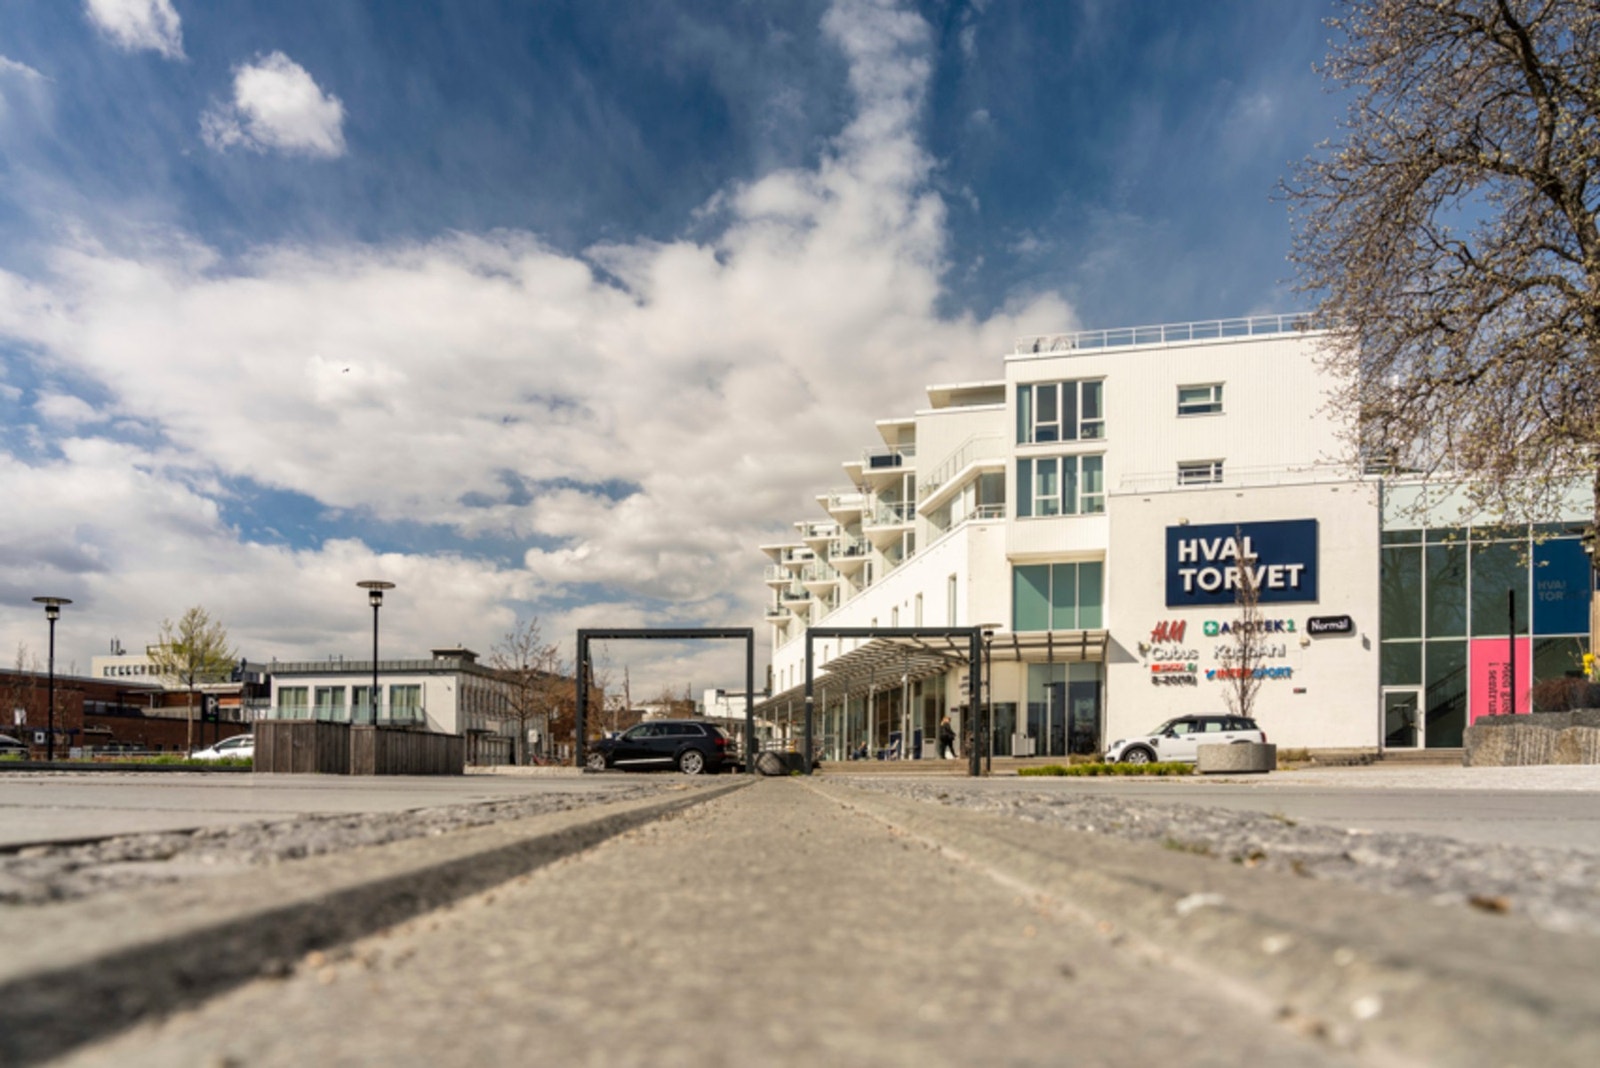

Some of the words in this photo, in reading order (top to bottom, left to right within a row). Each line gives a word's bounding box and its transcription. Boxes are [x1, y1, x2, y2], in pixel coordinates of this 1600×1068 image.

[1177, 535, 1258, 562] HVAL
[1178, 563, 1304, 592] TORVET
[1220, 619, 1285, 634] APOTEK
[1311, 618, 1349, 632] Normal
[1152, 645, 1199, 661] Cubus
